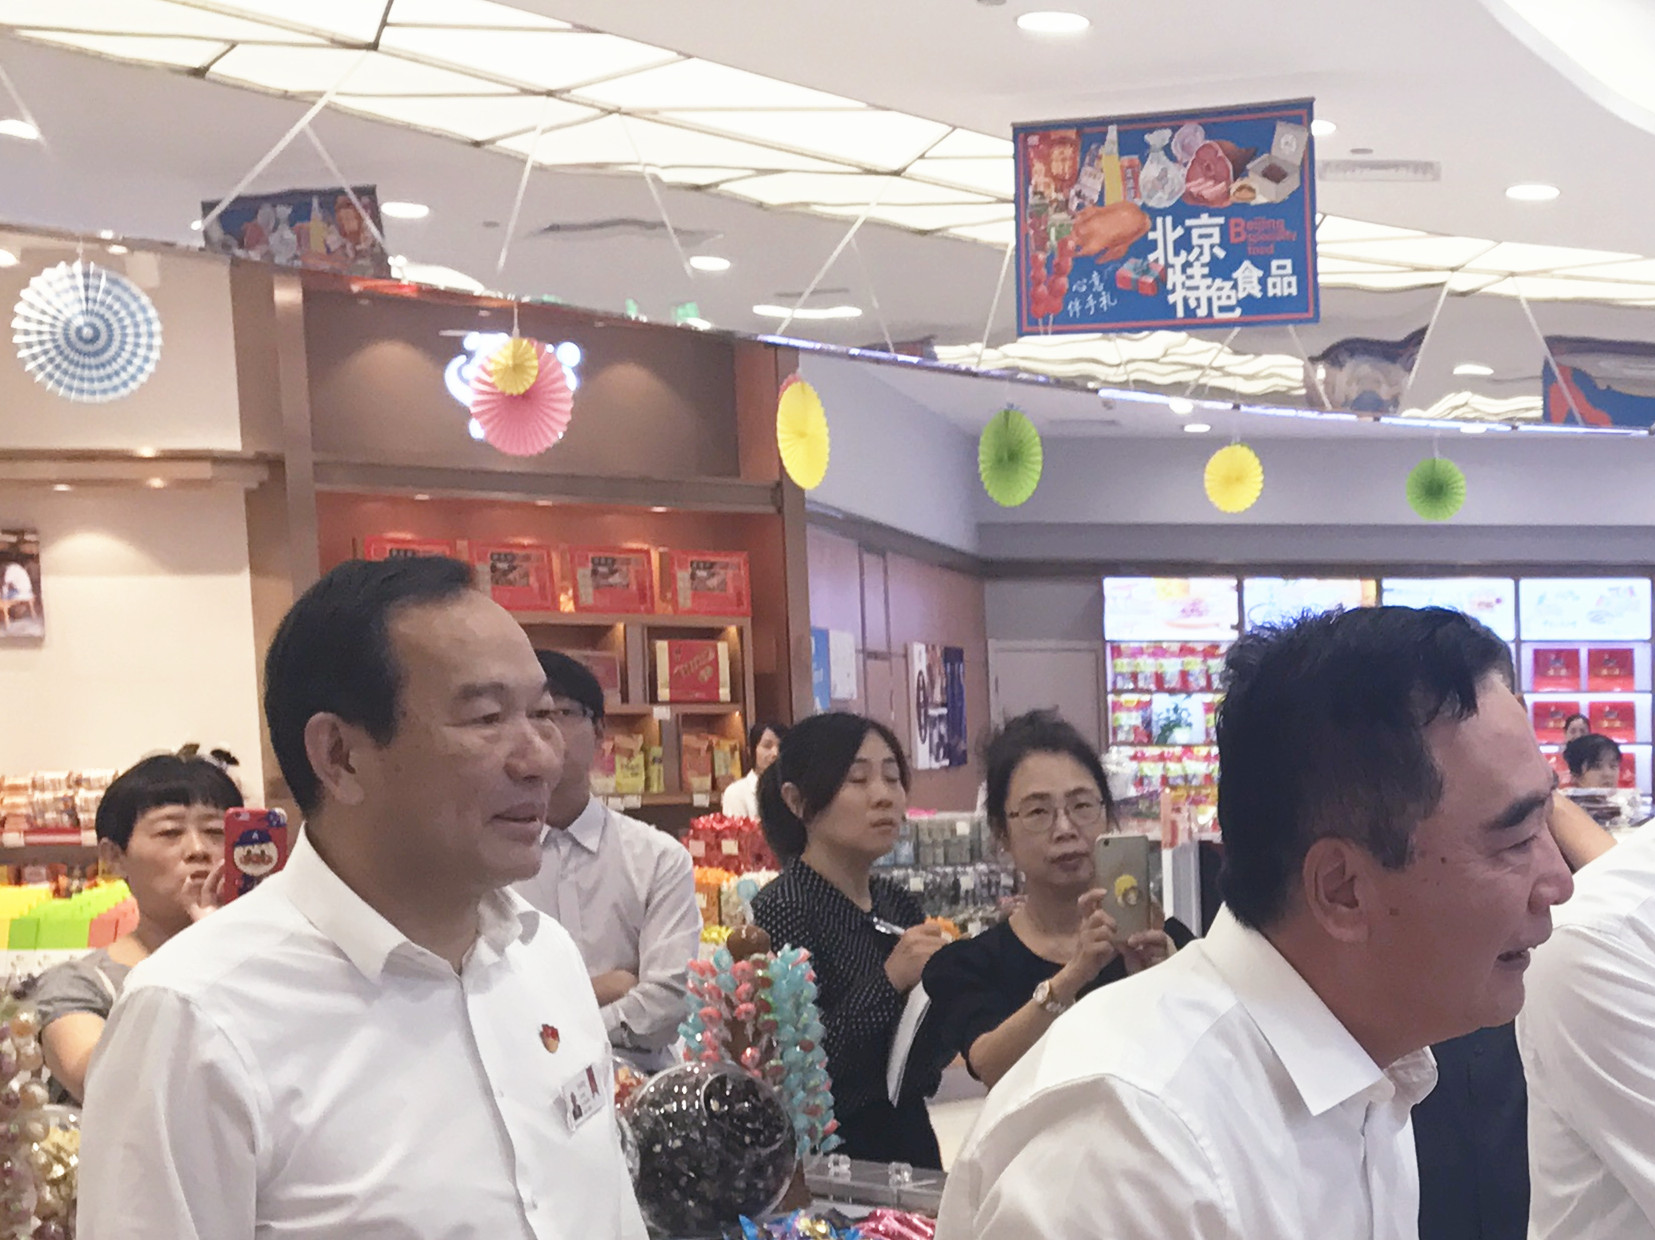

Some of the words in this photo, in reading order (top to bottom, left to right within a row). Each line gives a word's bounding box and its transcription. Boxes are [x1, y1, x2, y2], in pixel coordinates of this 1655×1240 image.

[1147, 213, 1227, 266] 北京
[1067, 296, 1118, 319] 伴手礼
[1166, 258, 1299, 320] 特色食品
